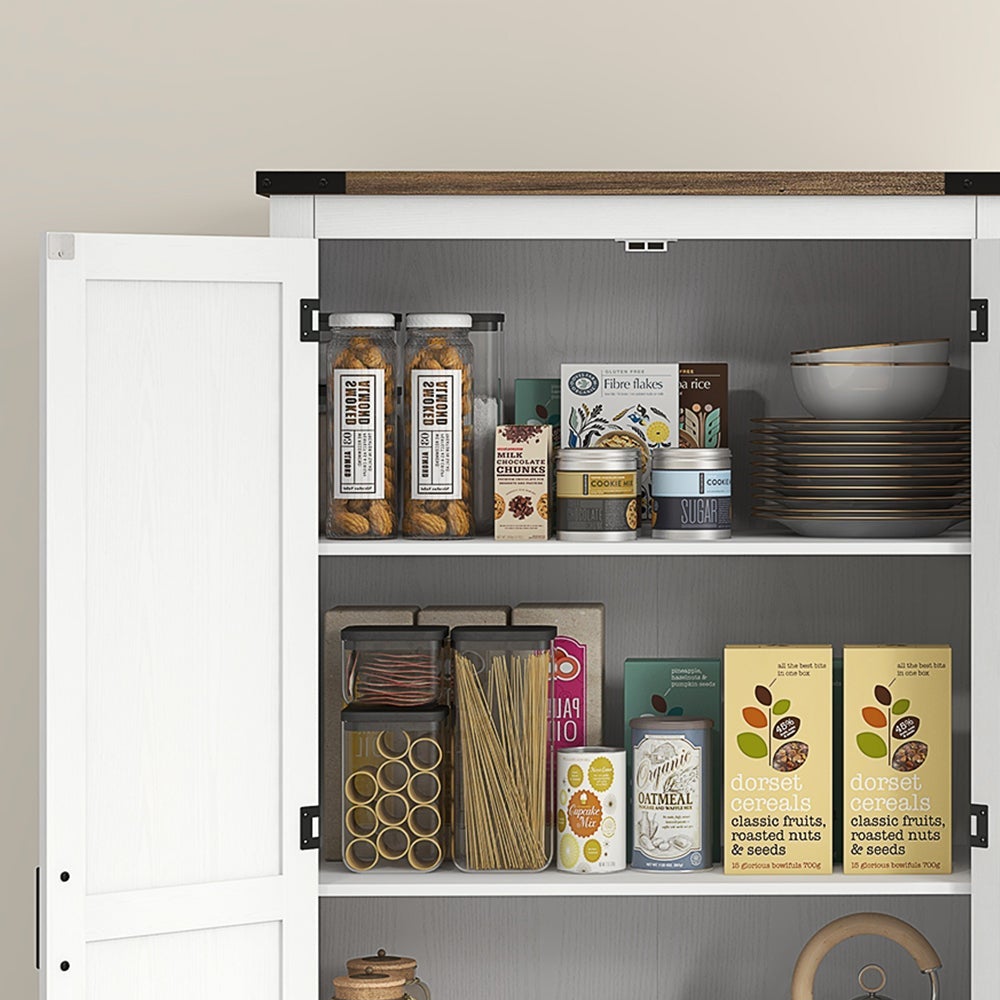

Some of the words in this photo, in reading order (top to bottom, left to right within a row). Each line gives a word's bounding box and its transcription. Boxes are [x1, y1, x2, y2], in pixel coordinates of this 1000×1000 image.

[604, 378, 631, 390] Fibre
[633, 378, 664, 390] flakes
[690, 378, 711, 390] rice
[496, 466, 546, 474] CHUNKS
[590, 480, 622, 488] COOKIE
[680, 498, 718, 524] SUGAR
[636, 749, 691, 790] Organic
[730, 774, 803, 791] dorset
[850, 774, 922, 791] dorset
[638, 792, 693, 805] OATMEAL
[730, 794, 812, 812] cereals
[850, 794, 931, 812] cereals
[569, 804, 600, 818] Cupcake
[580, 817, 597, 828] Mix
[731, 815, 779, 827] classic
[782, 815, 826, 828] fruits,
[850, 815, 898, 827] classic
[902, 815, 945, 828] fruits,
[731, 830, 784, 841] roasted
[788, 830, 822, 841] nuts
[850, 830, 904, 841] roasted
[908, 830, 941, 841] nuts
[731, 844, 744, 856] &
[747, 844, 786, 856] seeds
[850, 844, 863, 856] &
[866, 844, 905, 856] seeds
